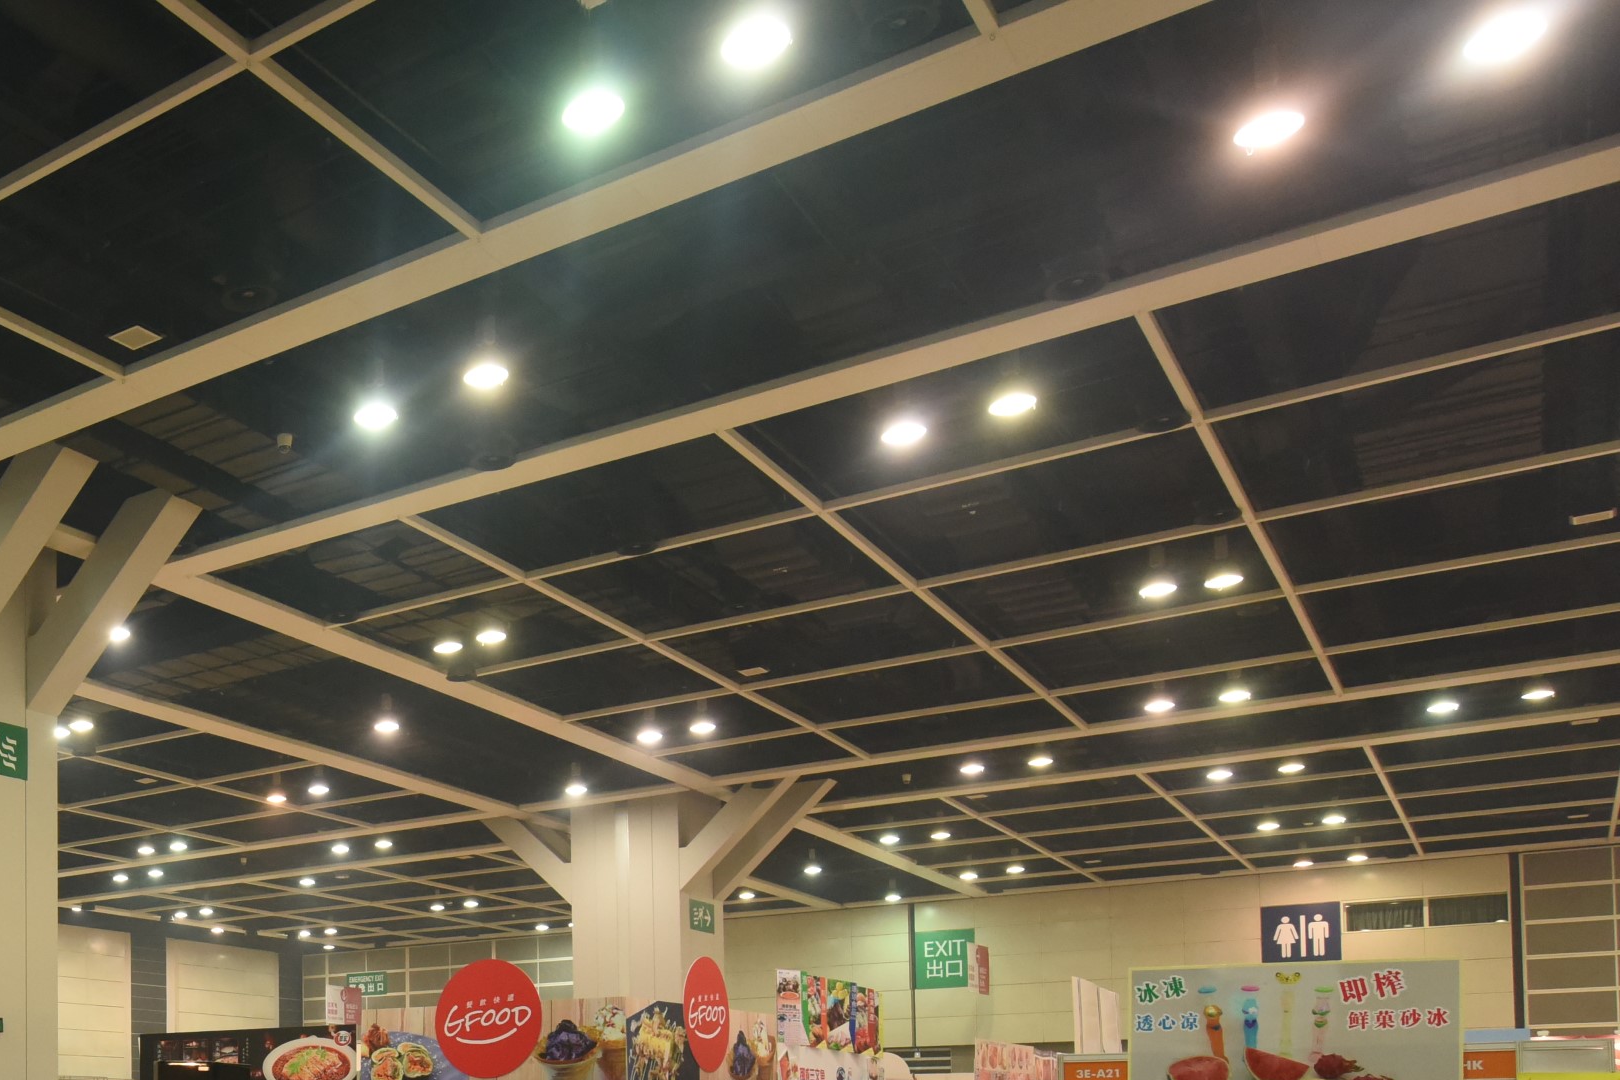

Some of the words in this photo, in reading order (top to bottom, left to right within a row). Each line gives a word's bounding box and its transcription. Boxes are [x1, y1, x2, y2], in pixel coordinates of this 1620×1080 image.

[924, 939, 965, 957] EXIT
[927, 959, 963, 979] 出口
[1136, 976, 1188, 1004] 冰凍
[1340, 970, 1406, 1004] 即榨
[1076, 1069, 1120, 1079] 3E-A21
